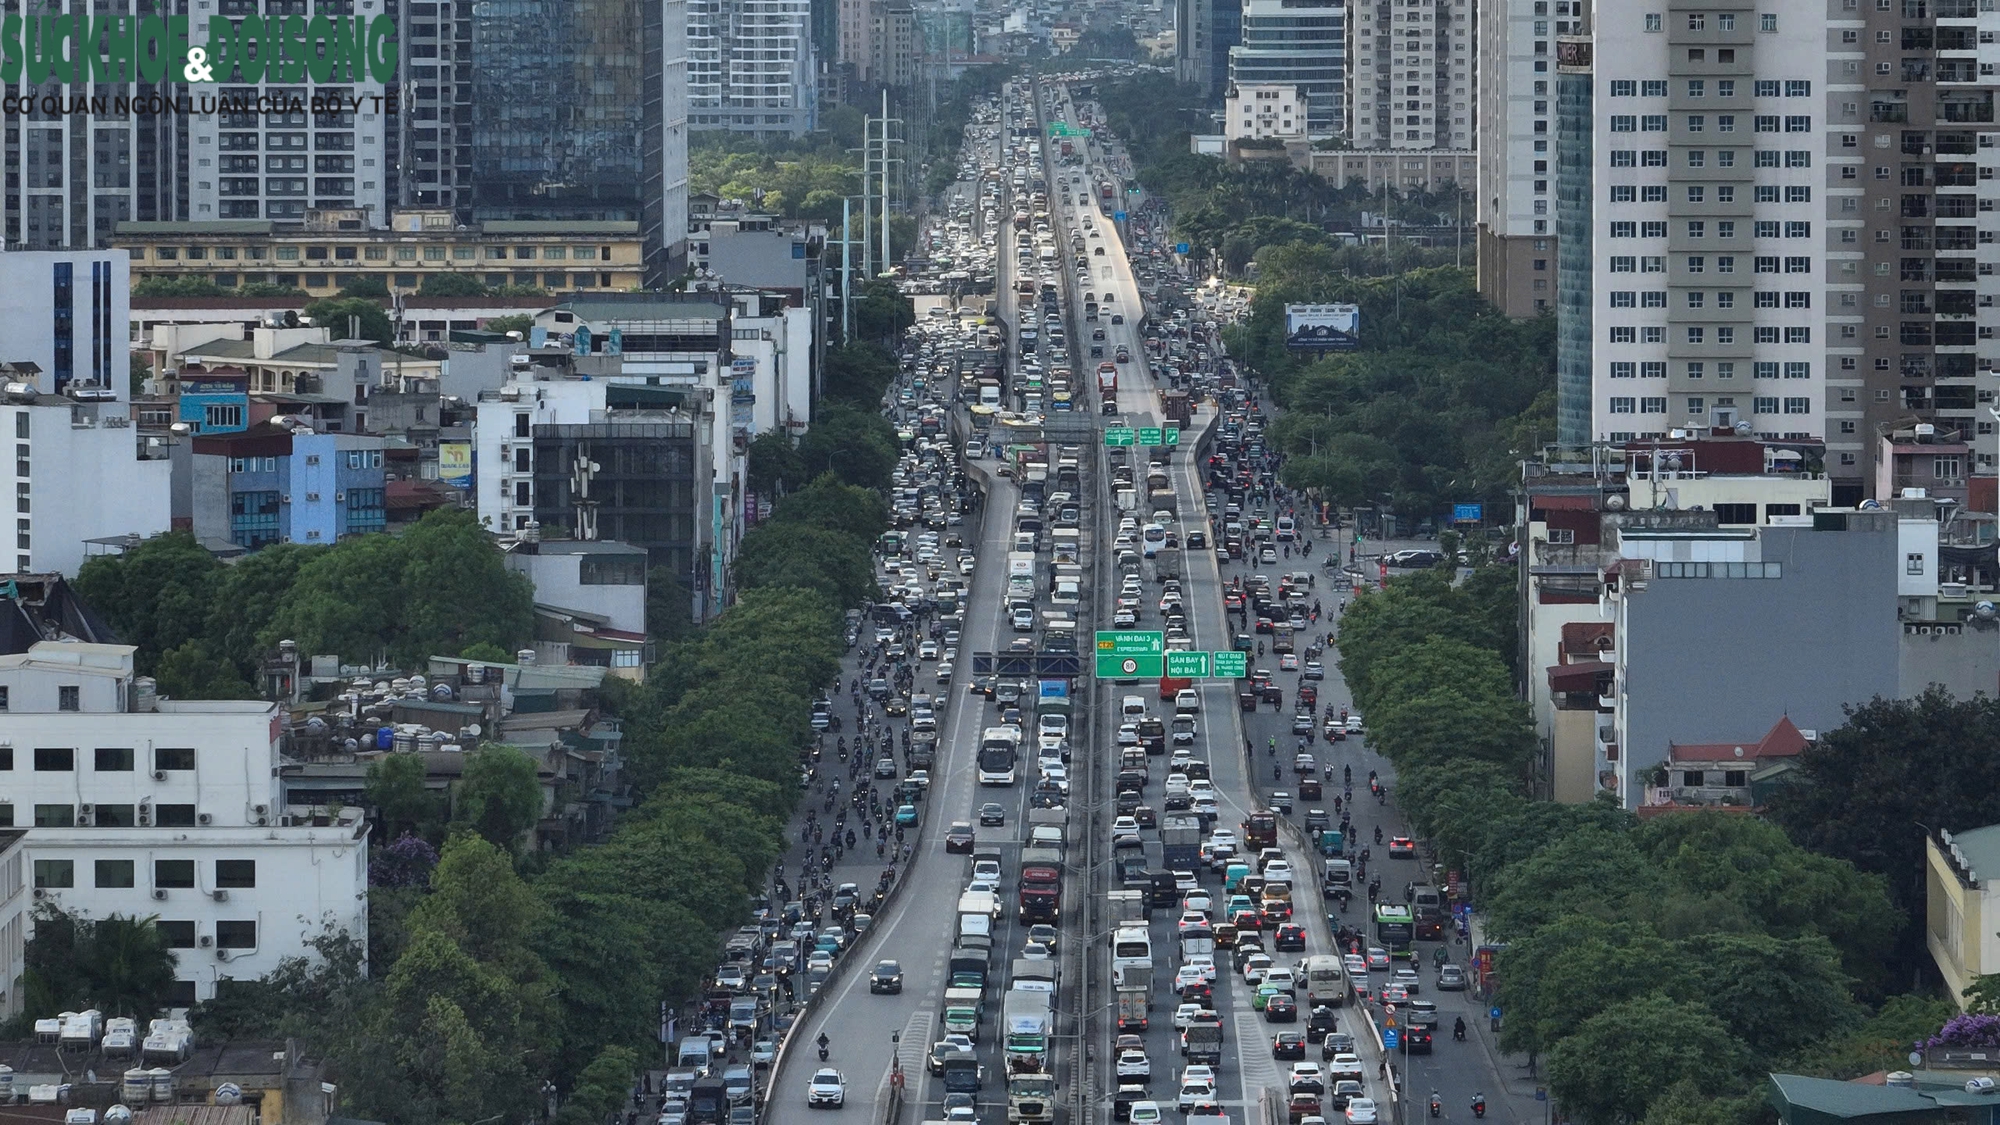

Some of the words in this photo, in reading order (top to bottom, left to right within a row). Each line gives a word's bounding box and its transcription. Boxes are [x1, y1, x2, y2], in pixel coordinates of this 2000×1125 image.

[1170, 655, 1185, 664] SÂN
[1185, 656, 1199, 664] BAY
[1170, 666, 1183, 674] NỘI
